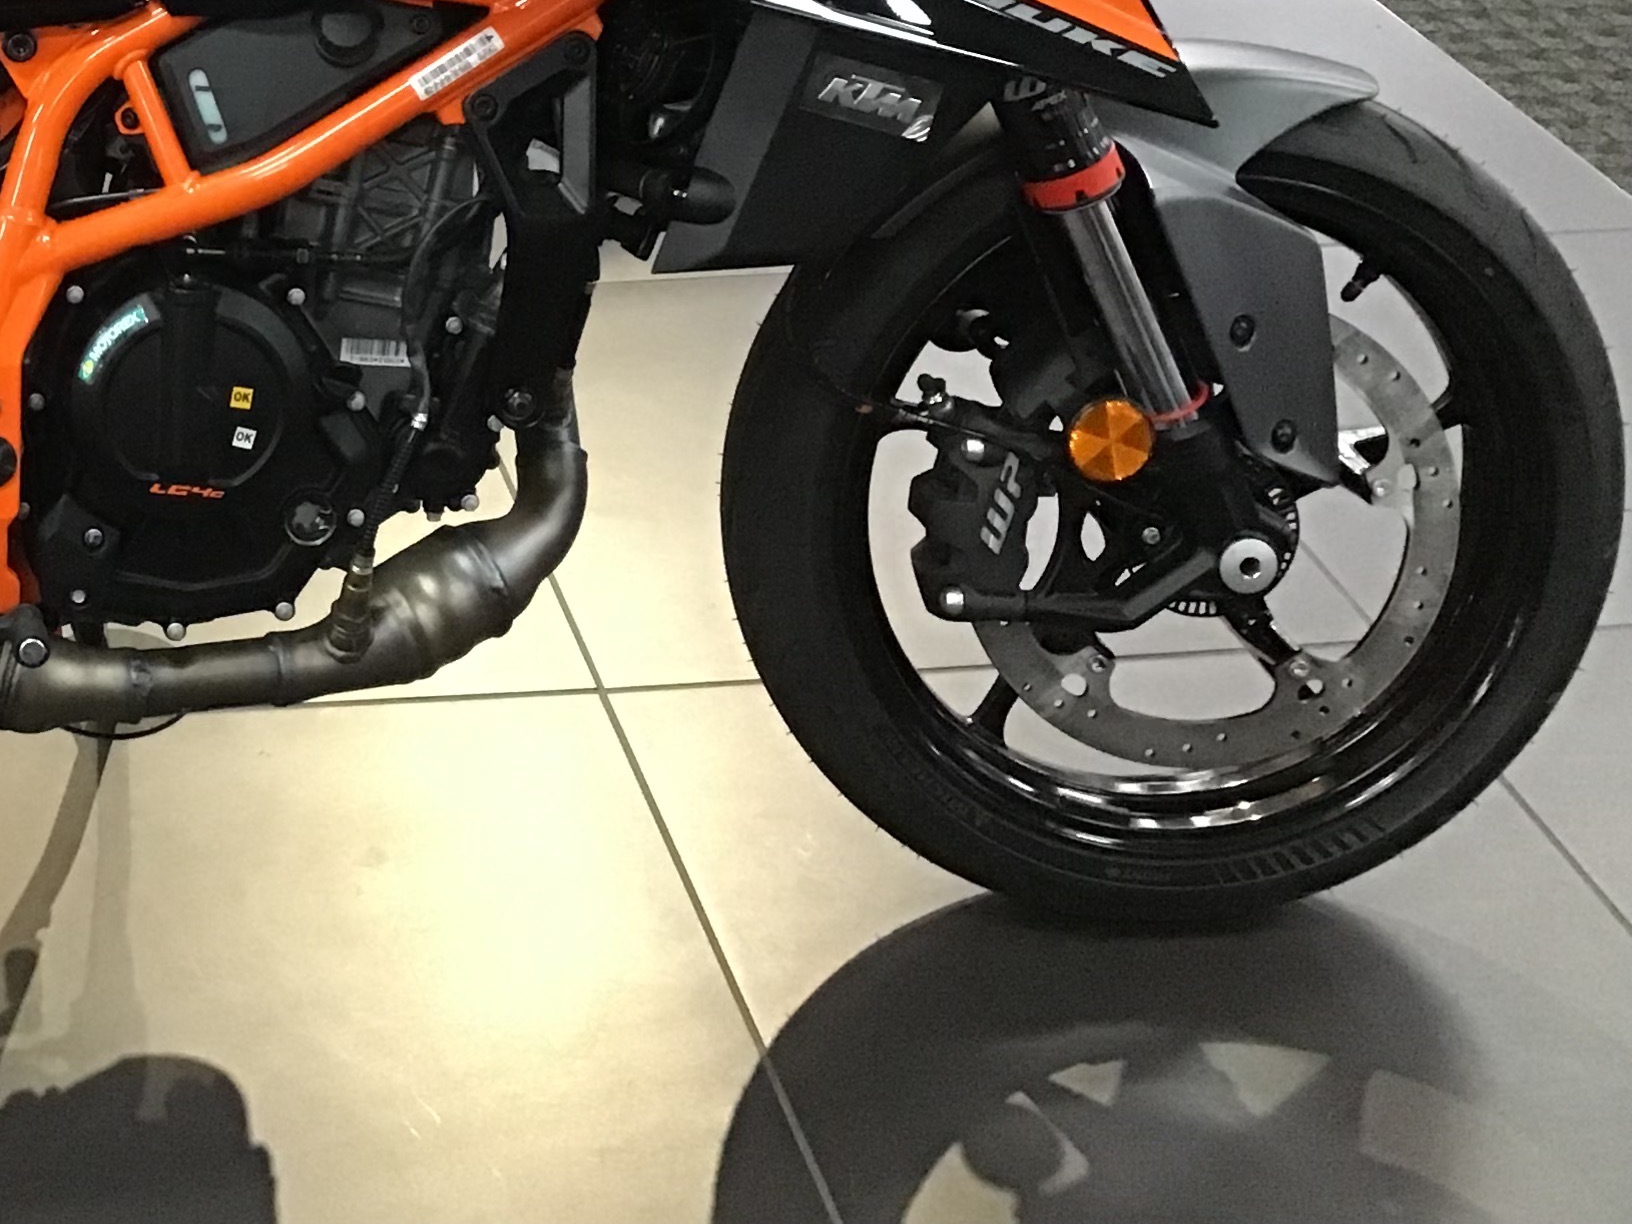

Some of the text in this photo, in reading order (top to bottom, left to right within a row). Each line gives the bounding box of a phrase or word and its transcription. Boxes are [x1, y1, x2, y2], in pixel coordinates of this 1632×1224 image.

[817, 74, 921, 124] KTM
[1004, 76, 1046, 102] W
[88, 311, 141, 362] MOTOREX
[233, 391, 251, 403] OK
[235, 431, 253, 444] OK
[980, 451, 1021, 555] WP
